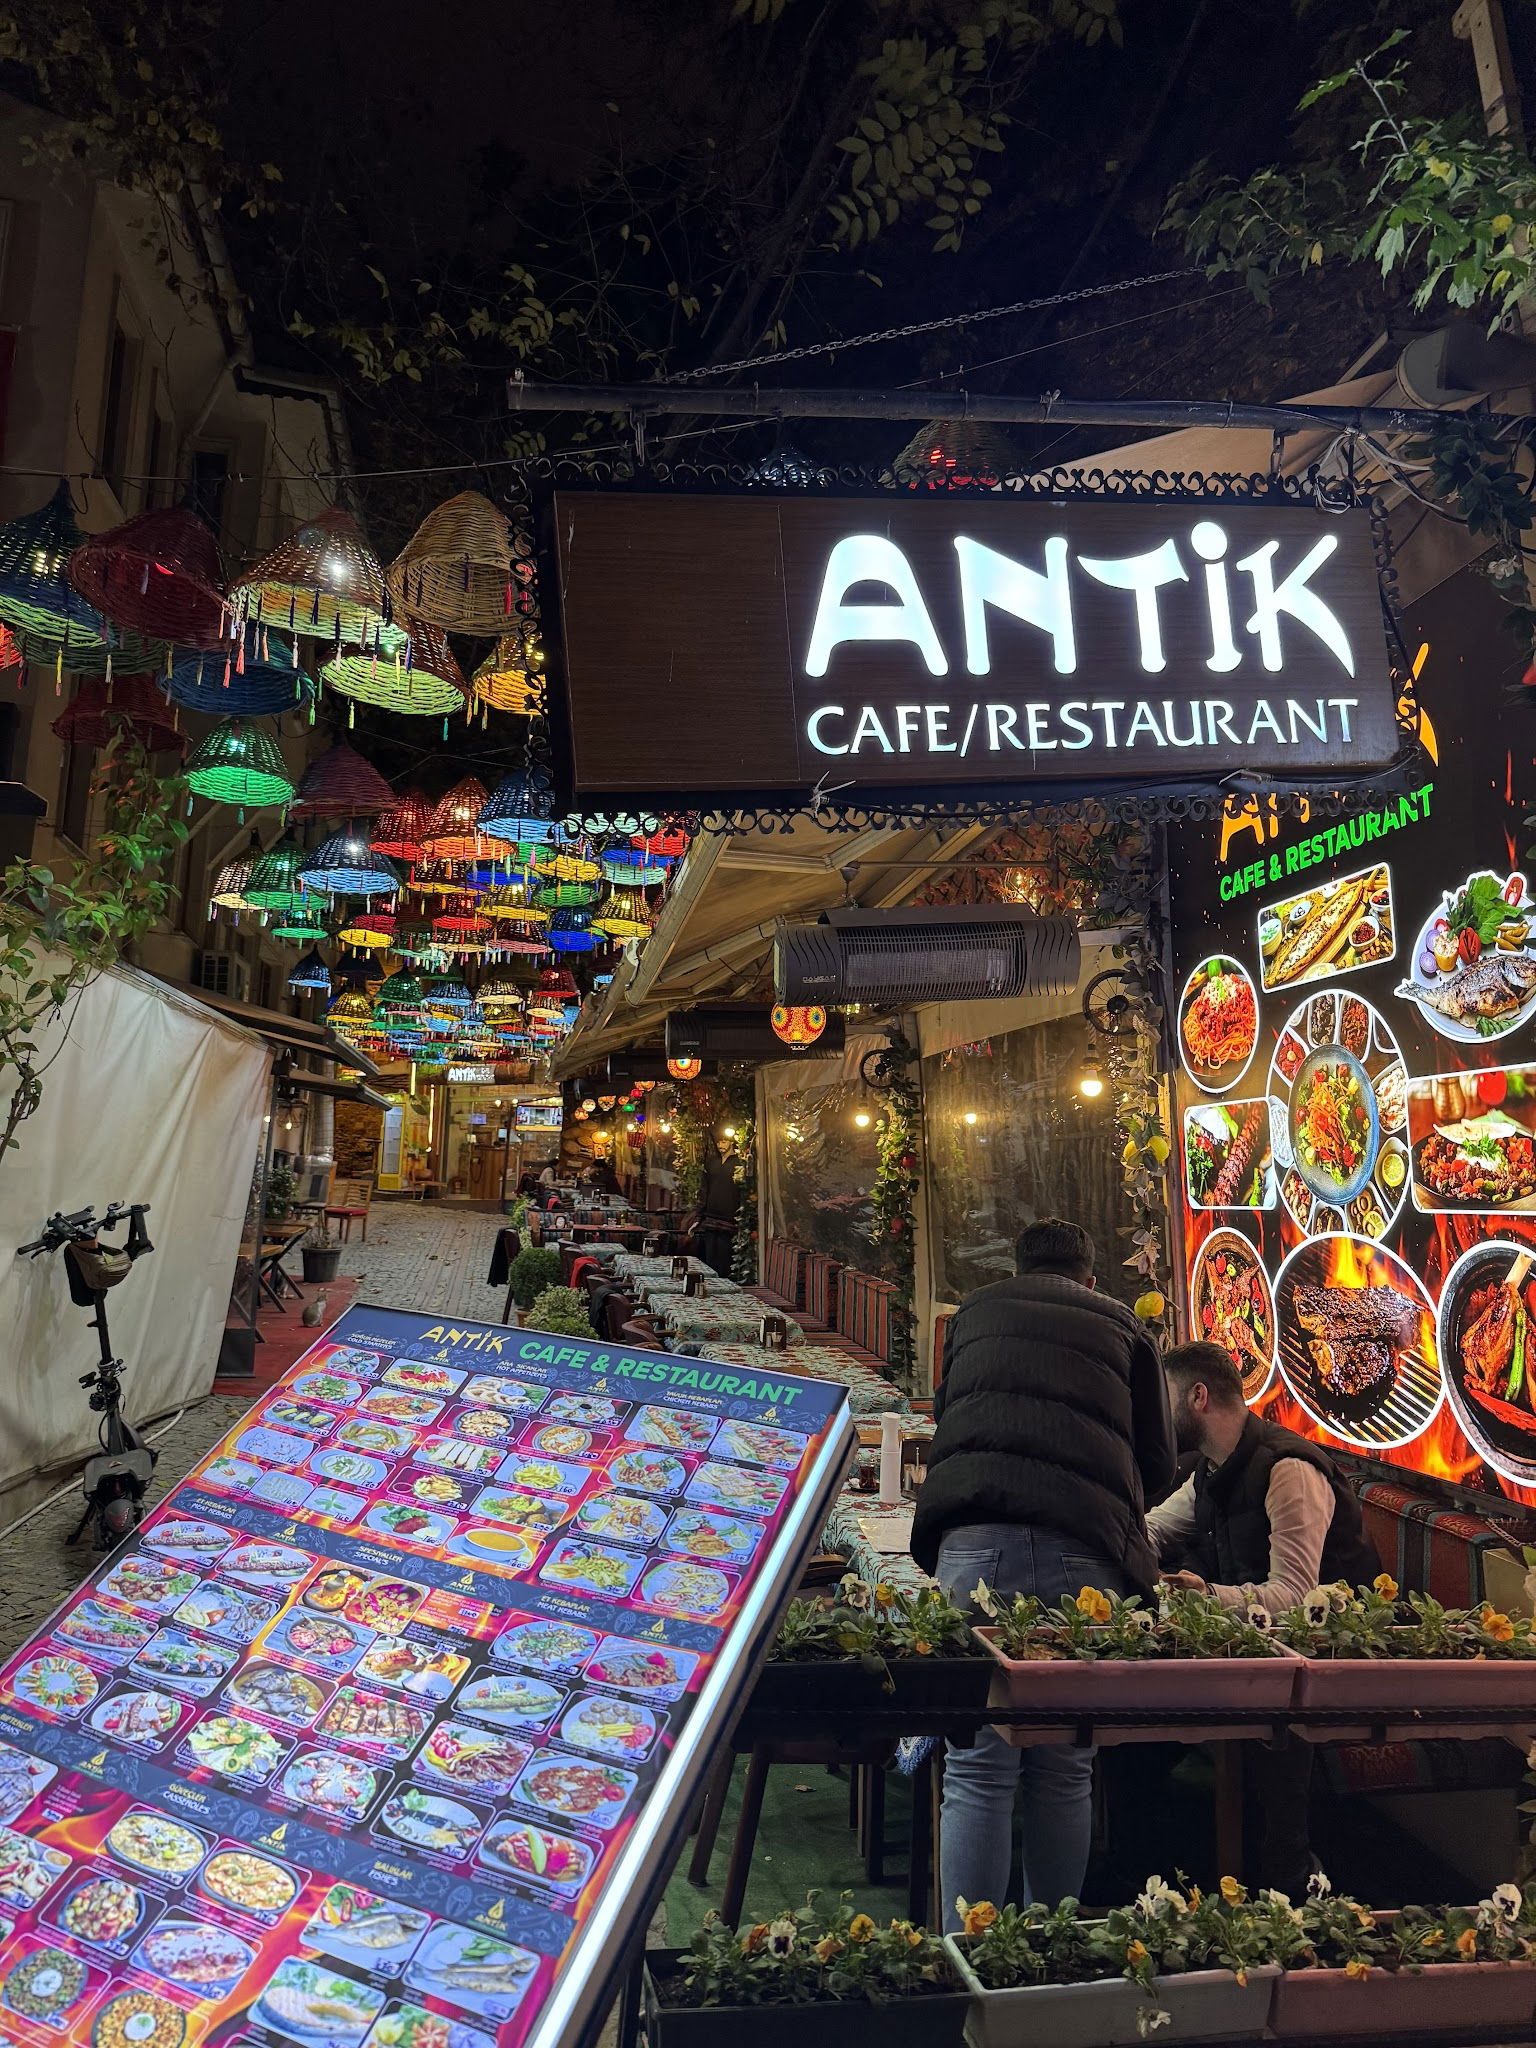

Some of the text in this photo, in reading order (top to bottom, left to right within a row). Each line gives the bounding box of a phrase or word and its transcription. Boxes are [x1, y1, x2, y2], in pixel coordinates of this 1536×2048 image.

[806, 698, 1360, 759] CAFE/RESTAURANT
[1219, 860, 1266, 901] CAFE
[1269, 853, 1284, 881] &
[1285, 783, 1434, 876] RESTAURANT
[519, 1342, 591, 1369] CAFE
[590, 1354, 610, 1373] &
[614, 1358, 802, 1405] RESTAURANT
[662, 1396, 718, 1409] CHICKEN KEBABS
[190, 1503, 209, 1511] MEAT
[536, 1602, 587, 1618] MEAT KEBABS
[161, 1791, 212, 1814] CASSEROLES
